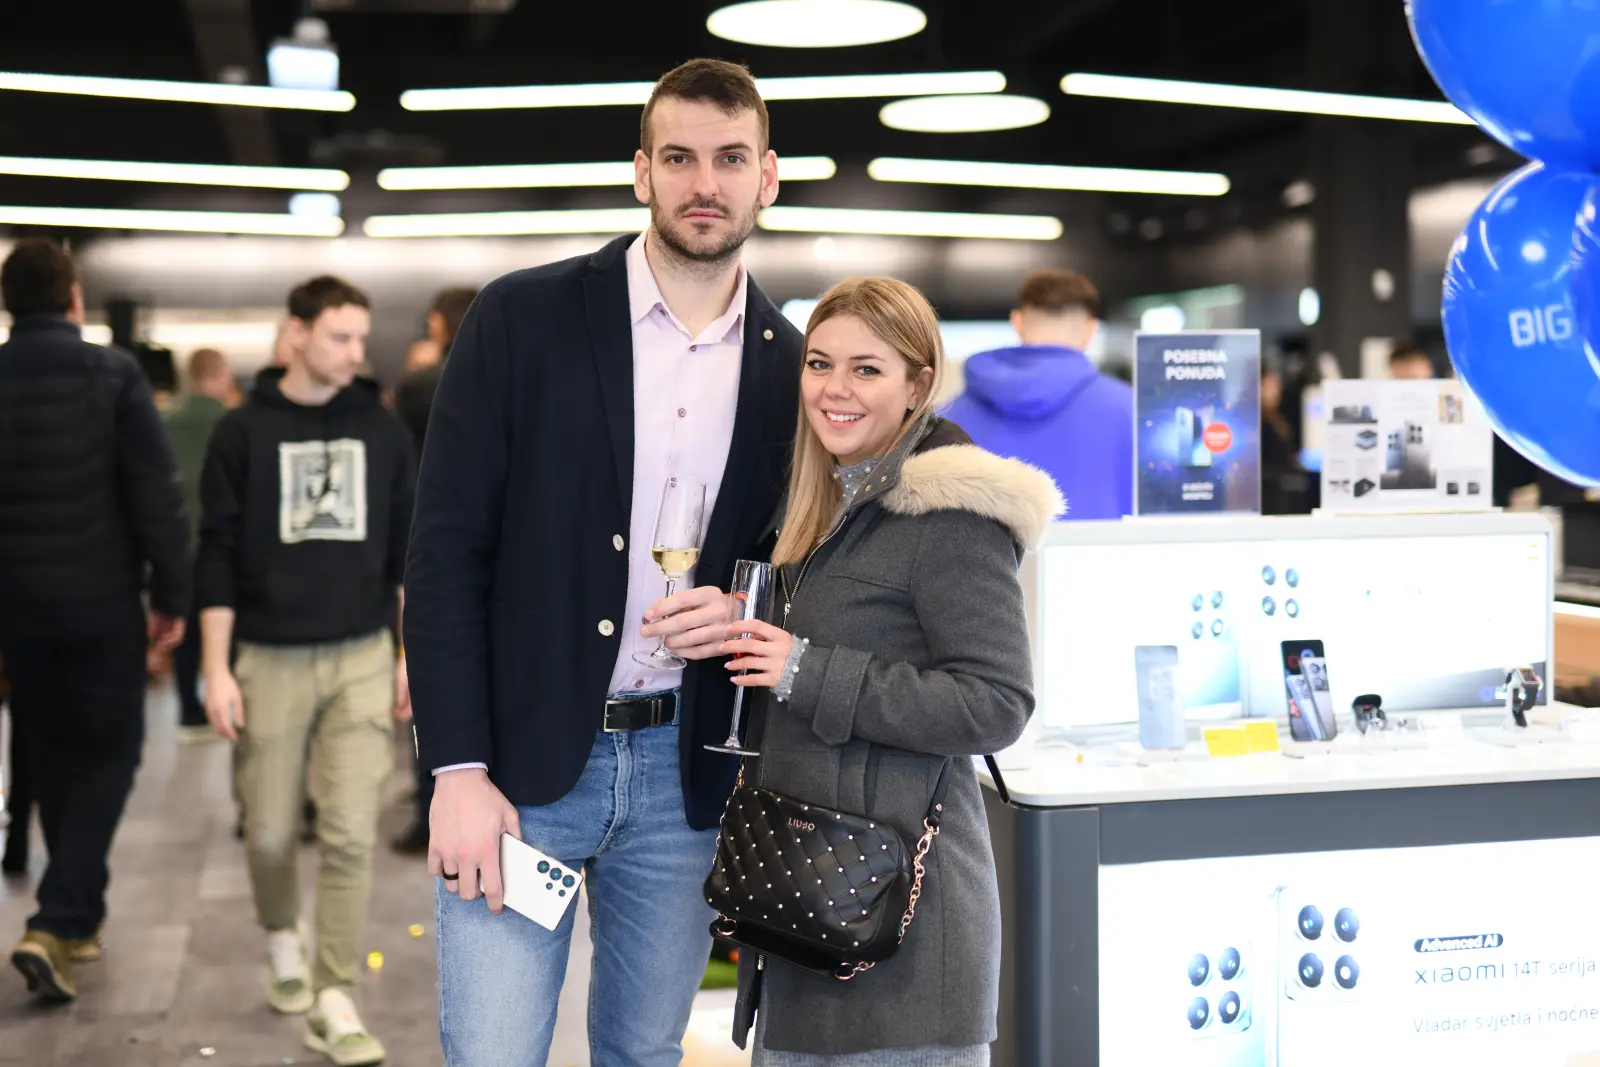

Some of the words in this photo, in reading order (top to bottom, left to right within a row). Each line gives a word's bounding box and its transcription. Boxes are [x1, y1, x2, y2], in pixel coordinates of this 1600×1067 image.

[1508, 304, 1572, 348] BIG
[1163, 348, 1228, 364] POSEBNA
[1165, 365, 1226, 381] PONUDA
[1420, 935, 1483, 952] Advanced
[1484, 933, 1498, 948] AI
[1513, 960, 1541, 979] 14T
[1549, 956, 1596, 979] serija
[1412, 1014, 1469, 1033] Vladar
[1475, 1011, 1532, 1032] svjetla
